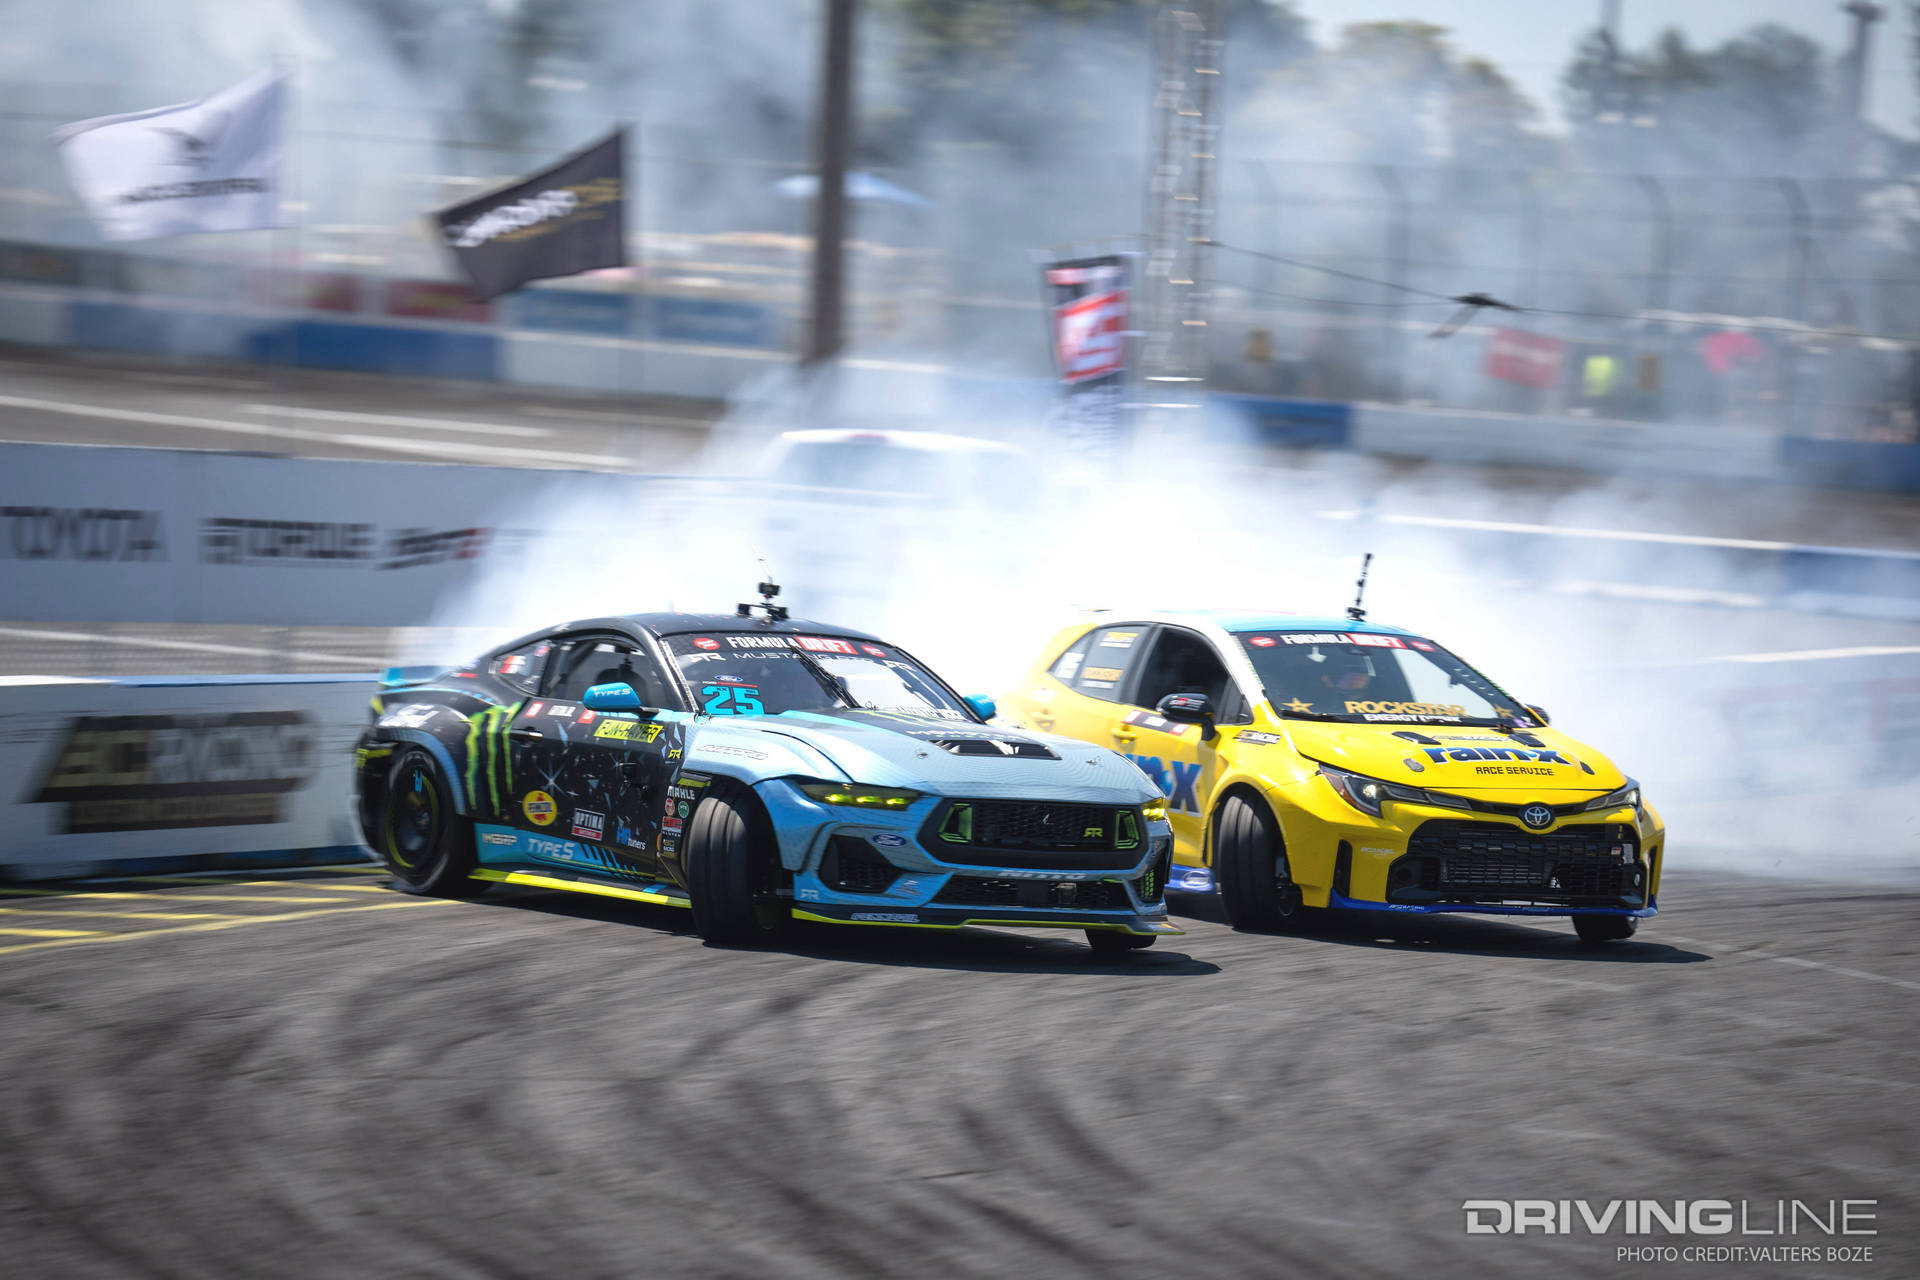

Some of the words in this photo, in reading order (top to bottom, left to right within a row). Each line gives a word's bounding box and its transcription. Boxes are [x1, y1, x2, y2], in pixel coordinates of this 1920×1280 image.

[726, 637, 802, 649] FORMULA
[803, 638, 852, 653] DRIFT
[702, 685, 764, 715] 25
[1344, 701, 1468, 717] ROCKSTAR
[1364, 714, 1421, 722] ENERGY
[1475, 767, 1504, 775] RACE
[1507, 768, 1554, 776] SERVICE
[668, 785, 695, 800] MAHLE
[574, 811, 603, 830] OPTIMA
[627, 839, 647, 850] tuners
